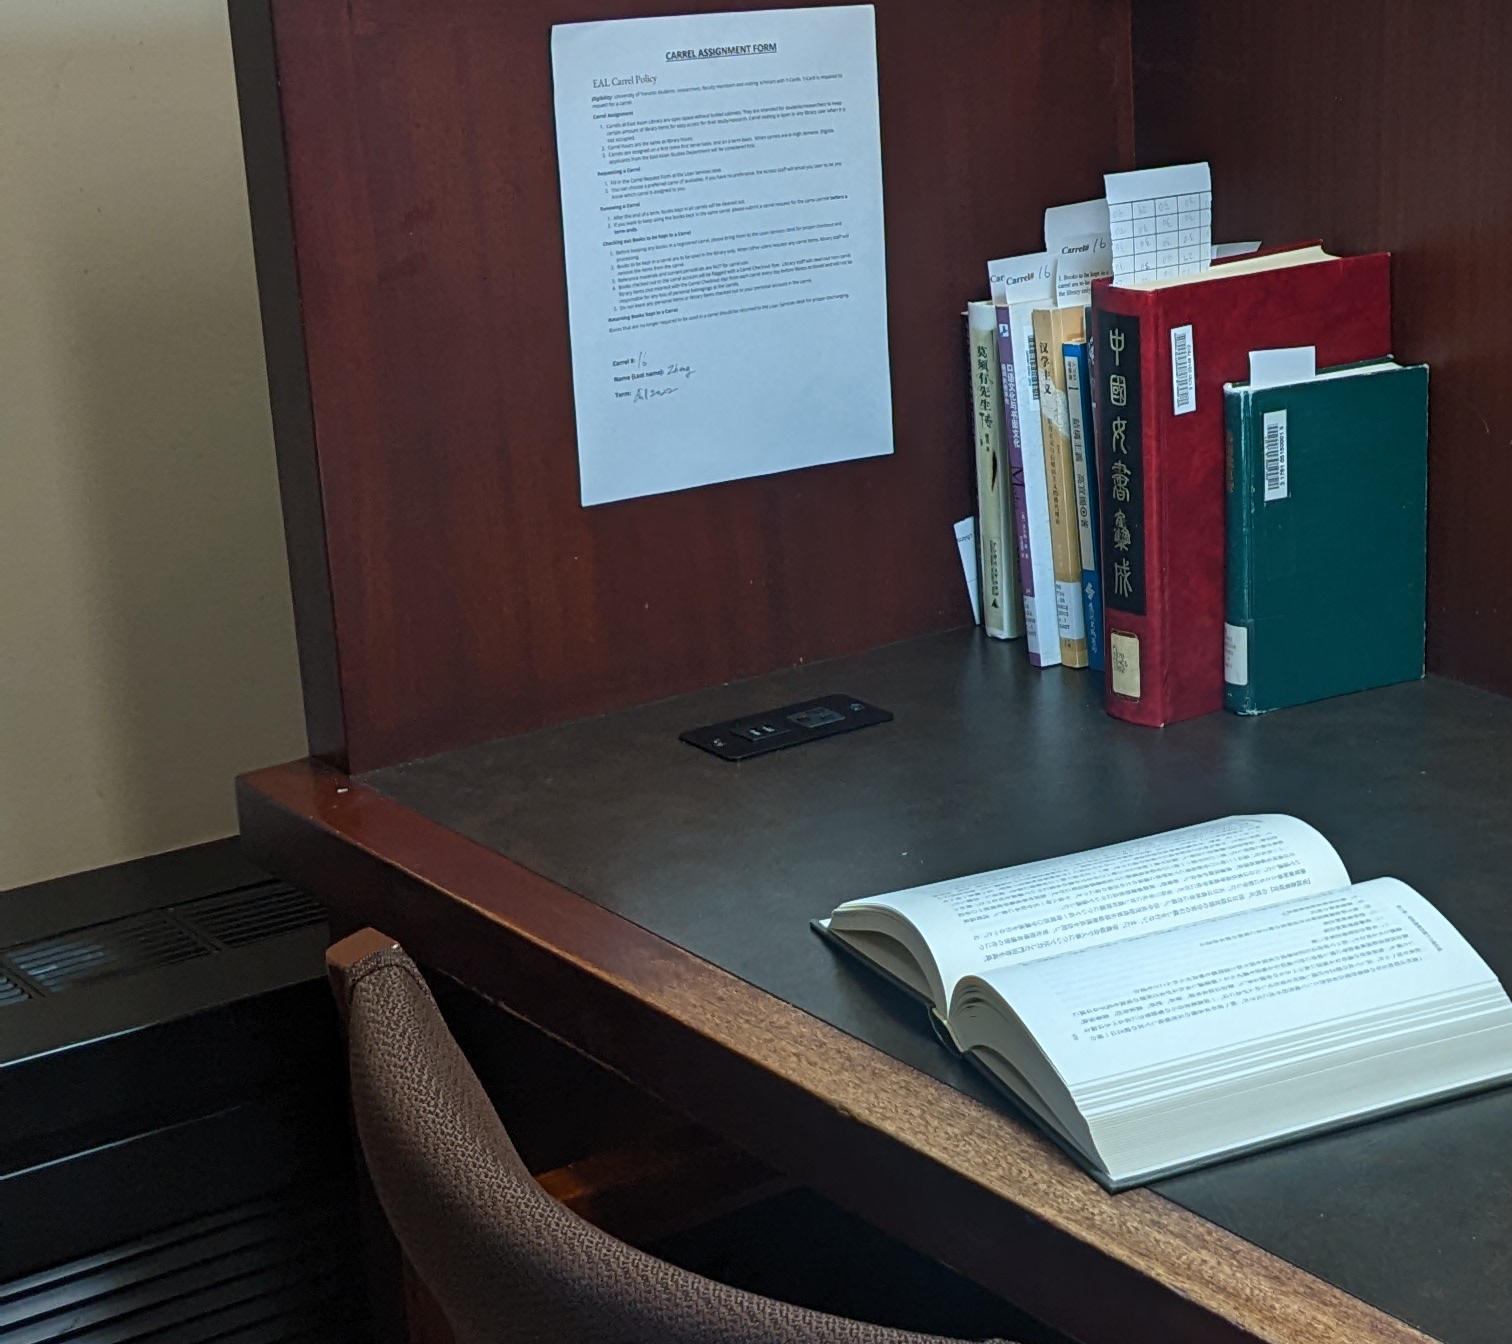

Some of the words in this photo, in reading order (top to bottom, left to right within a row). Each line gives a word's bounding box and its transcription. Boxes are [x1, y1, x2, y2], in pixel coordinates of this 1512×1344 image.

[665, 49, 695, 60] CARREL
[698, 44, 751, 57] ASSIGNMENT
[752, 42, 776, 52] FORM
[592, 78, 610, 88] EAL
[611, 75, 634, 85] Carrel
[635, 73, 657, 85] Policy
[1092, 237, 1107, 253] 16
[1038, 264, 1051, 279] 16
[1039, 342, 1052, 395] 汉学主义
